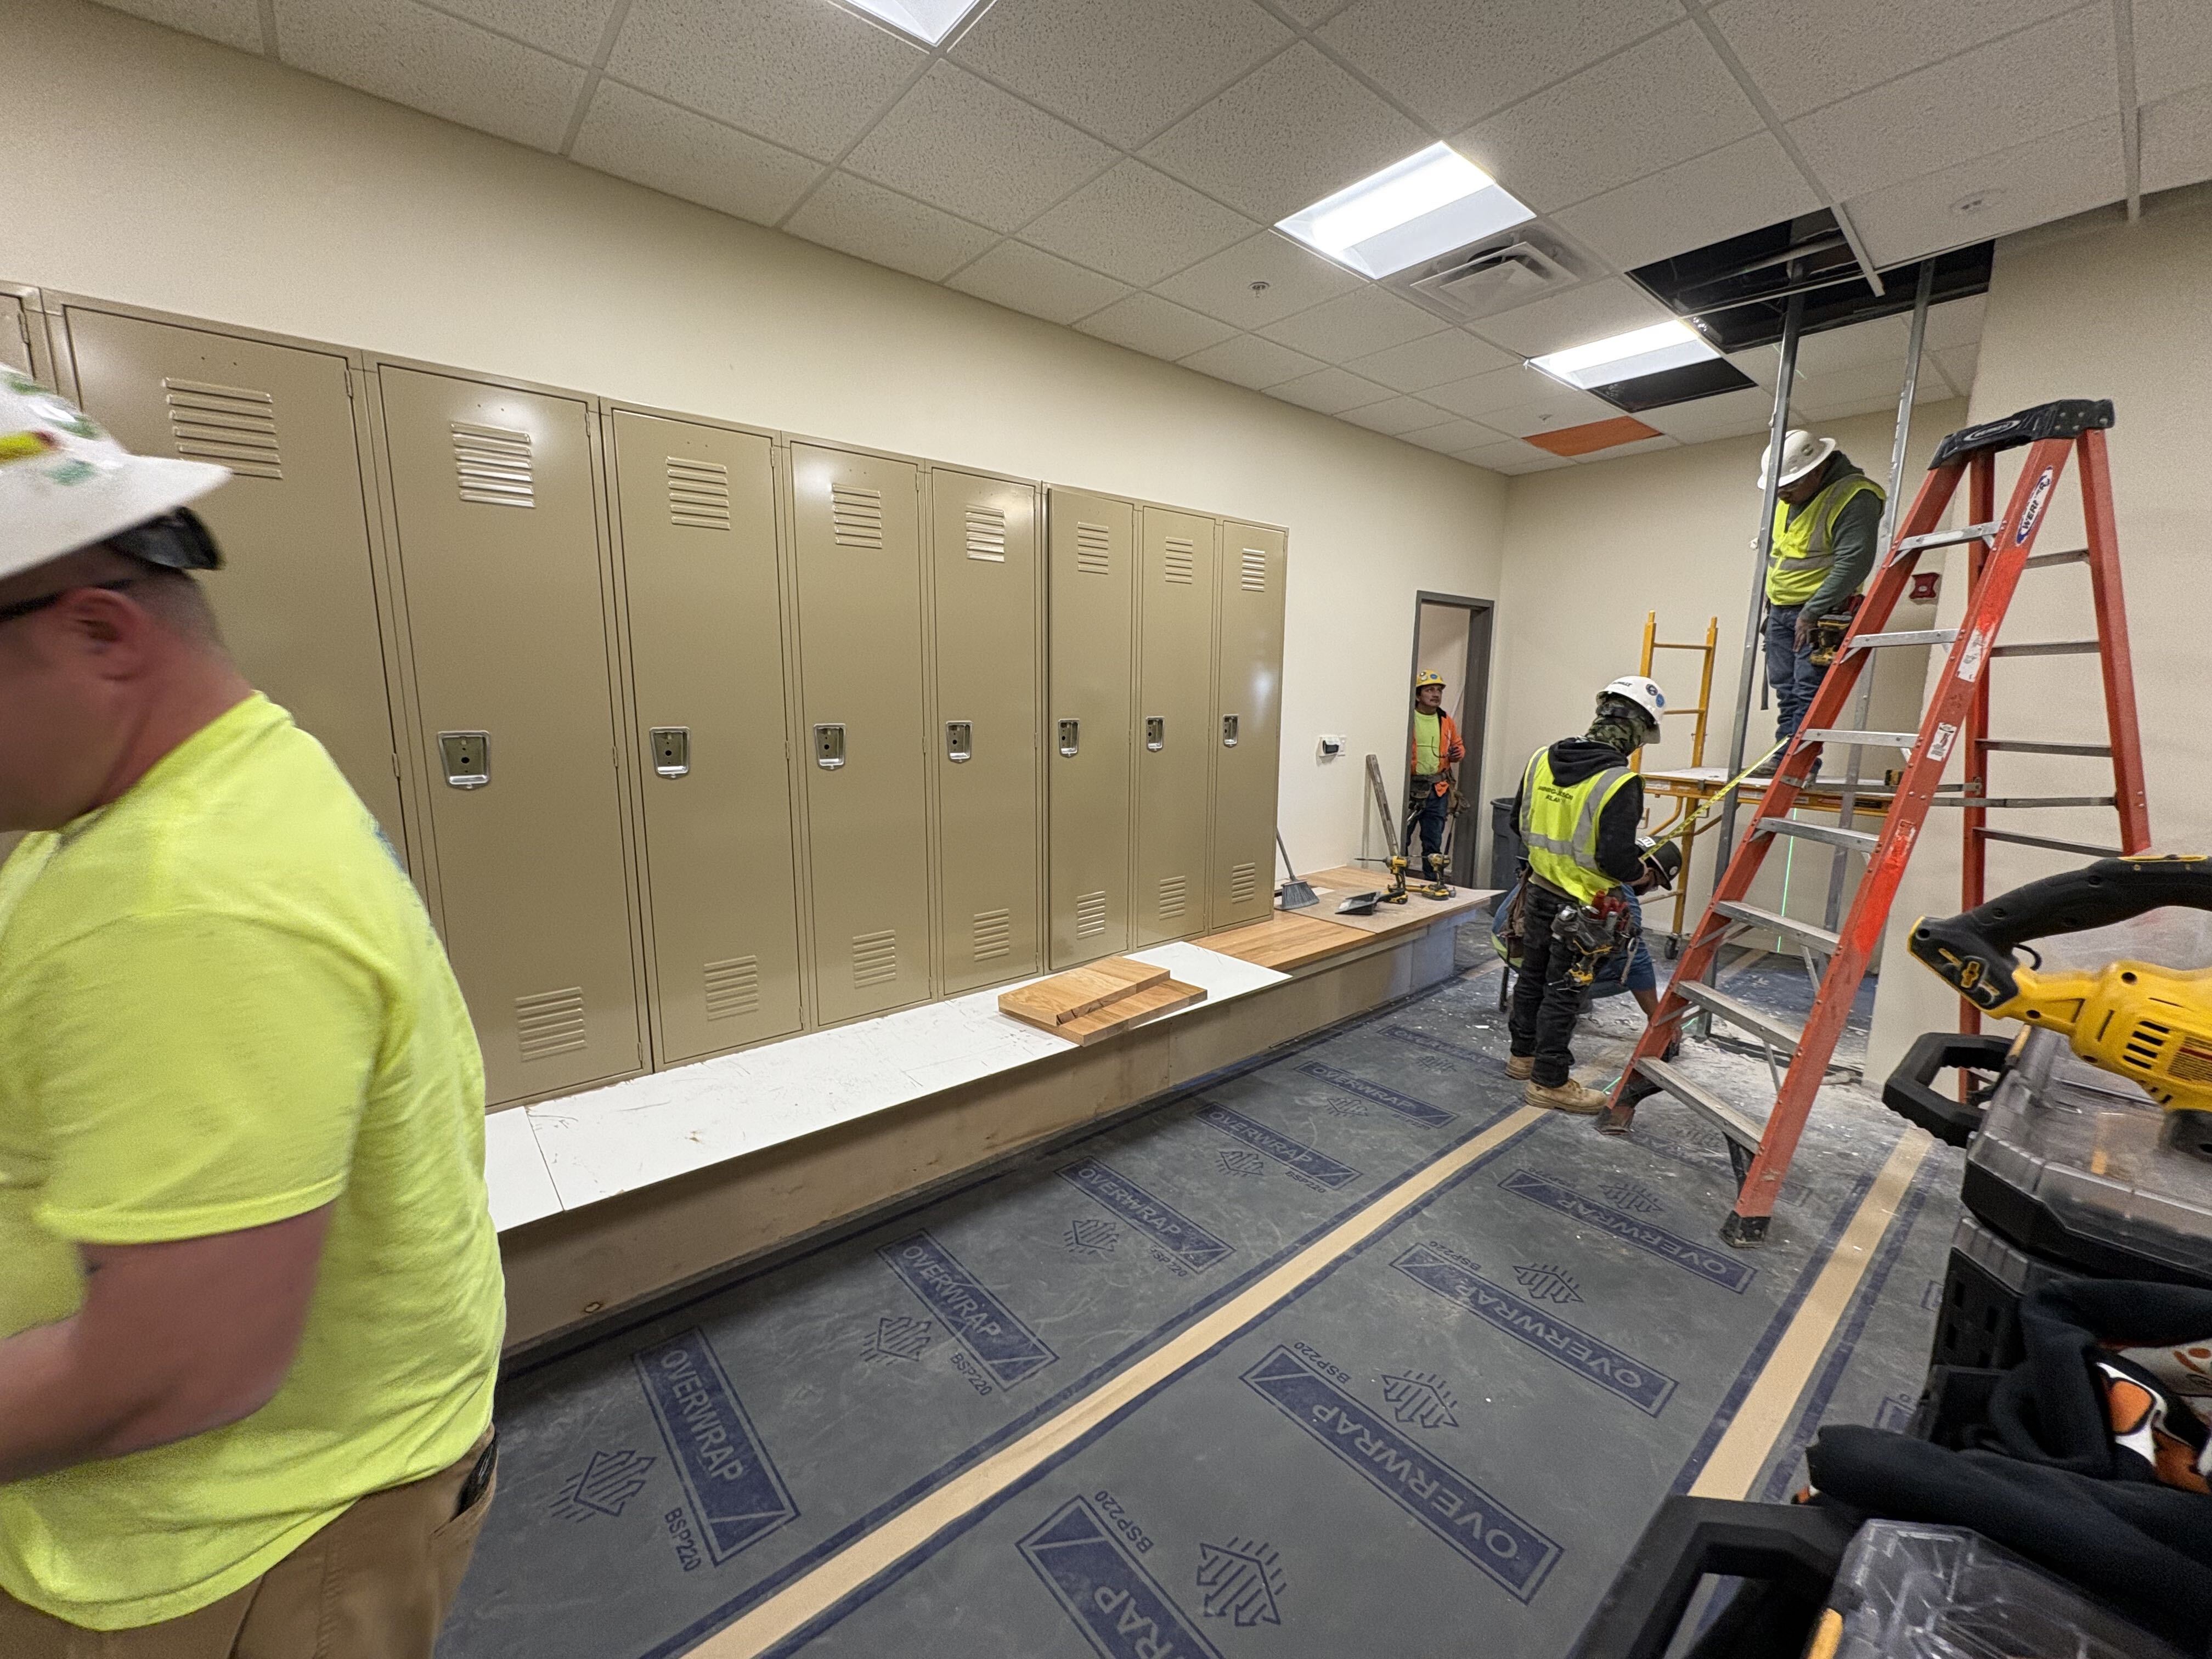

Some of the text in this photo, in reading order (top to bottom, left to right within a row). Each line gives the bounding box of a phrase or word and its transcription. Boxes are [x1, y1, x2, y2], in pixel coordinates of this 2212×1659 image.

[1313, 1066, 1415, 1107] OVERWRAP
[1209, 1110, 1313, 1165] OVERWRAP
[1077, 1167, 1182, 1237] OVERWRAP
[1285, 1171, 1326, 1193] BSP220
[1430, 1241, 1481, 1271] BSP220
[1556, 1199, 1728, 1275] OVERWRAP
[902, 1245, 1002, 1337] OVERWRAP
[1293, 1341, 1351, 1385] BSP220
[1454, 1284, 1642, 1388] OVERWRAP
[949, 1352, 992, 1397] BSP220
[661, 1348, 744, 1482] OVERWRAP
[1312, 1402, 1519, 1559] OVERWRAP
[664, 1507, 701, 1572] BSP220
[1094, 1489, 1153, 1554] BSP220
